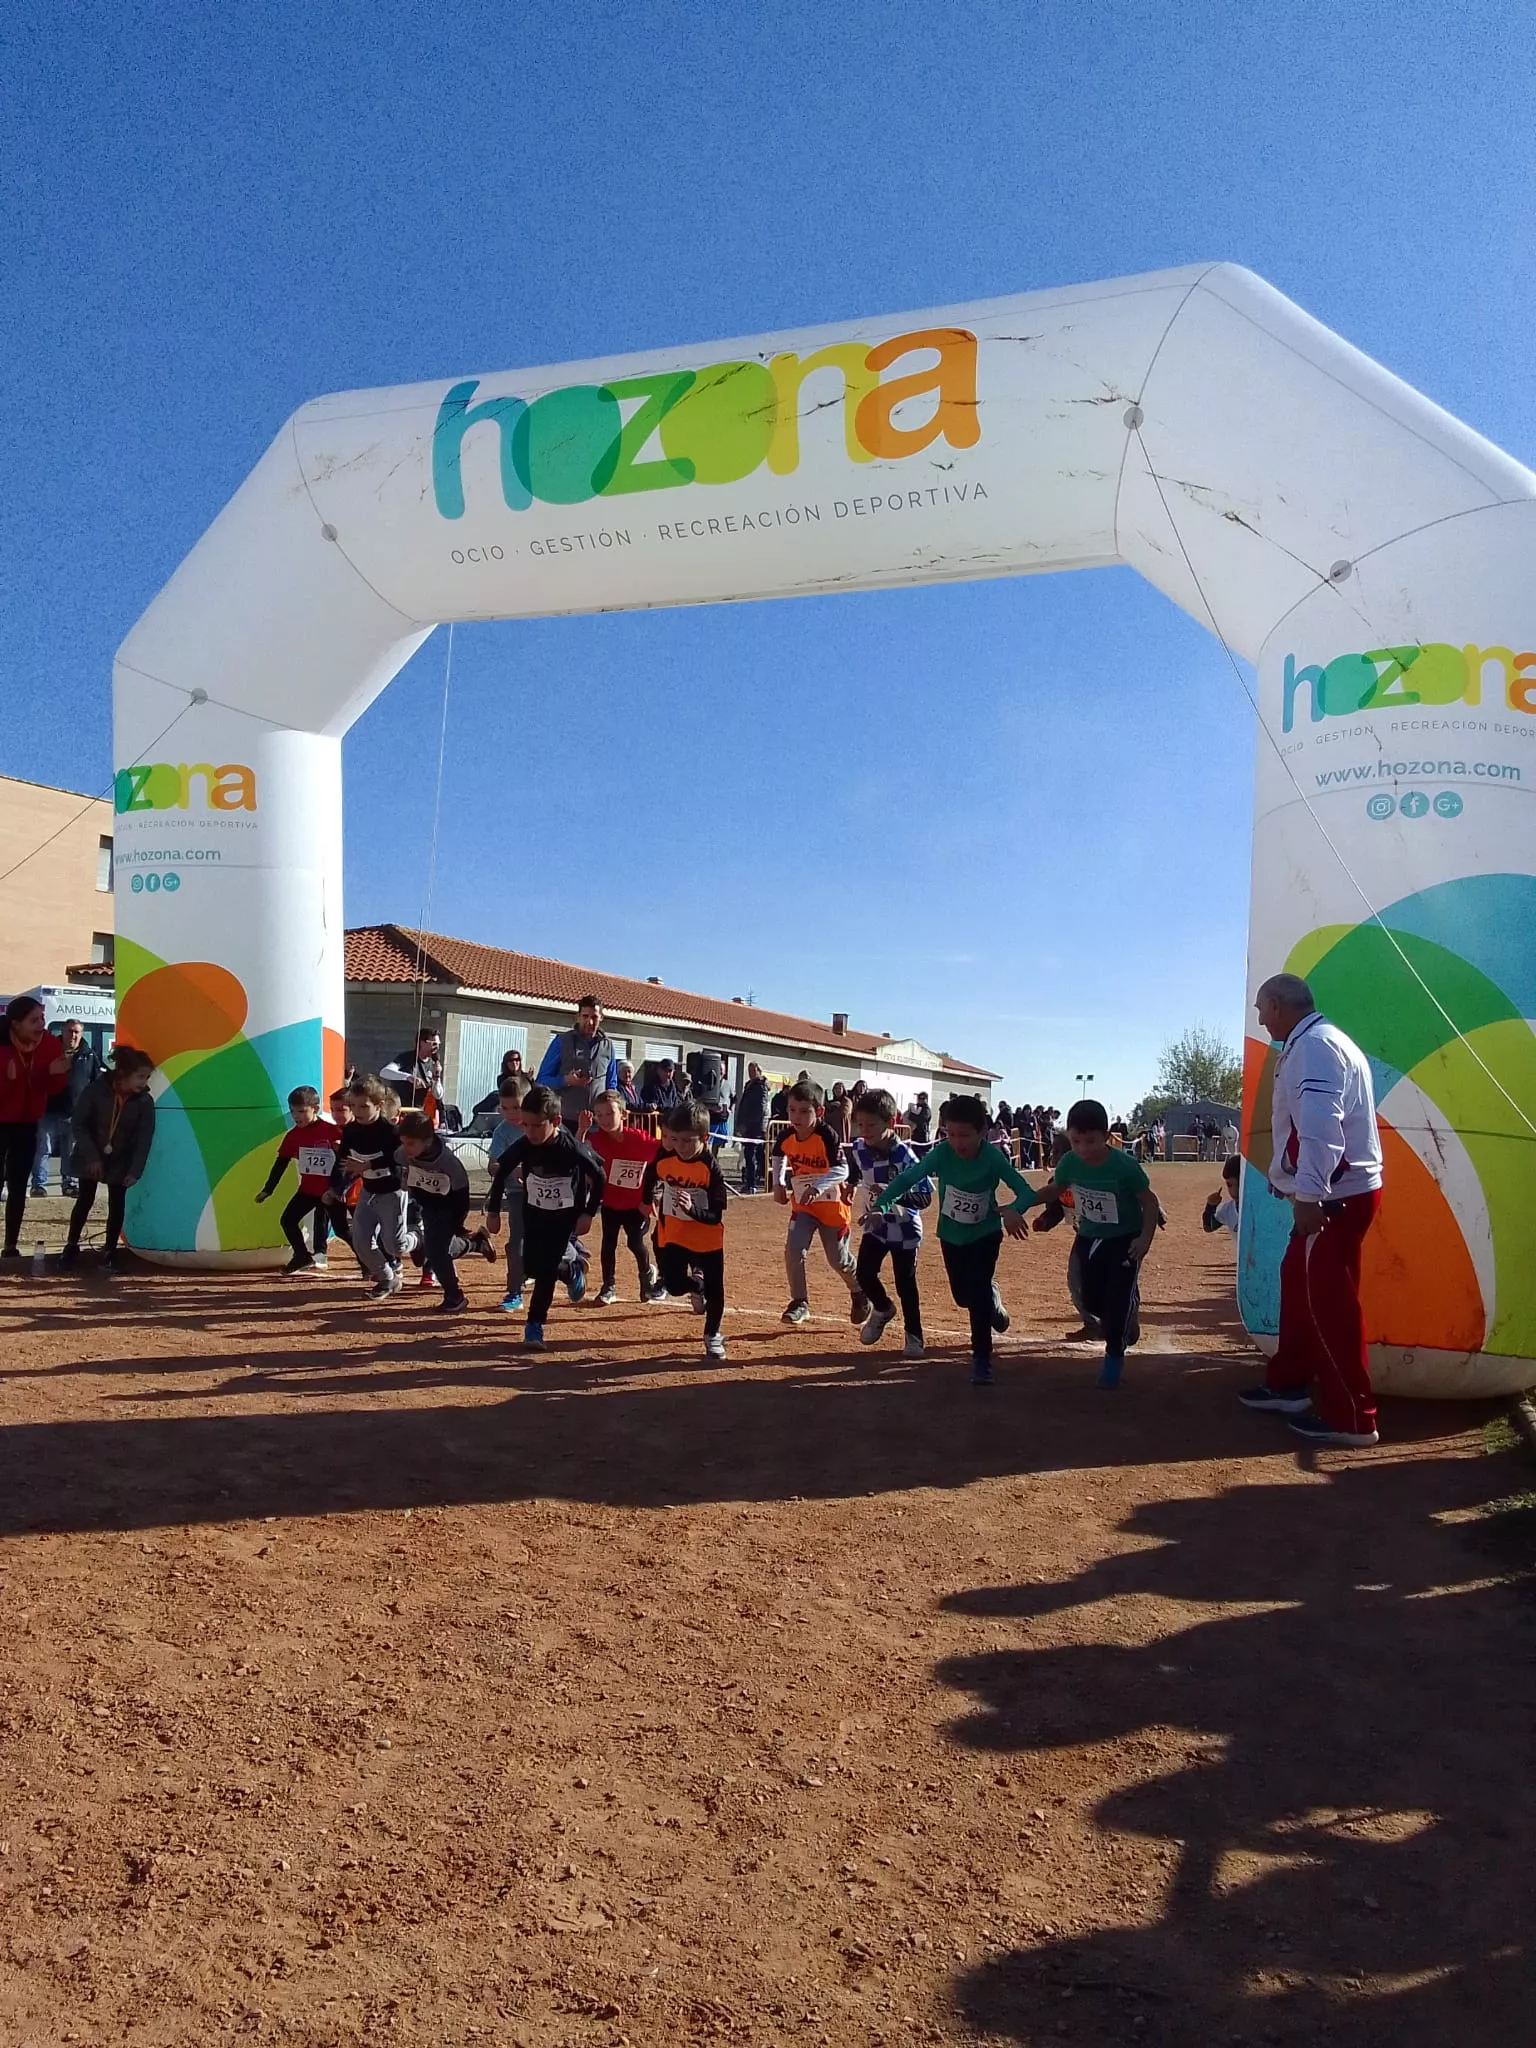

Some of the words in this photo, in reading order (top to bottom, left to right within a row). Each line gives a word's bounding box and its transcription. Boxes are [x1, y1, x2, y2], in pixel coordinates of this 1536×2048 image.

[432, 327, 980, 520] hozona
[451, 545, 504, 564] OCIO
[529, 527, 632, 557] GESTIÓN
[657, 503, 821, 541] RECREACIÓN
[834, 481, 989, 519] DEPORTIVA
[1315, 759, 1521, 788] www.hozona.com
[199, 820, 258, 830] DEPORTIVA
[56, 1004, 115, 1016] AMBULAN
[308, 1156, 326, 1167] 125
[620, 1169, 640, 1179] 261
[420, 1176, 440, 1187] 320
[537, 1187, 561, 1199] 323
[953, 1199, 979, 1214] 229
[1080, 1196, 1105, 1212] 234
